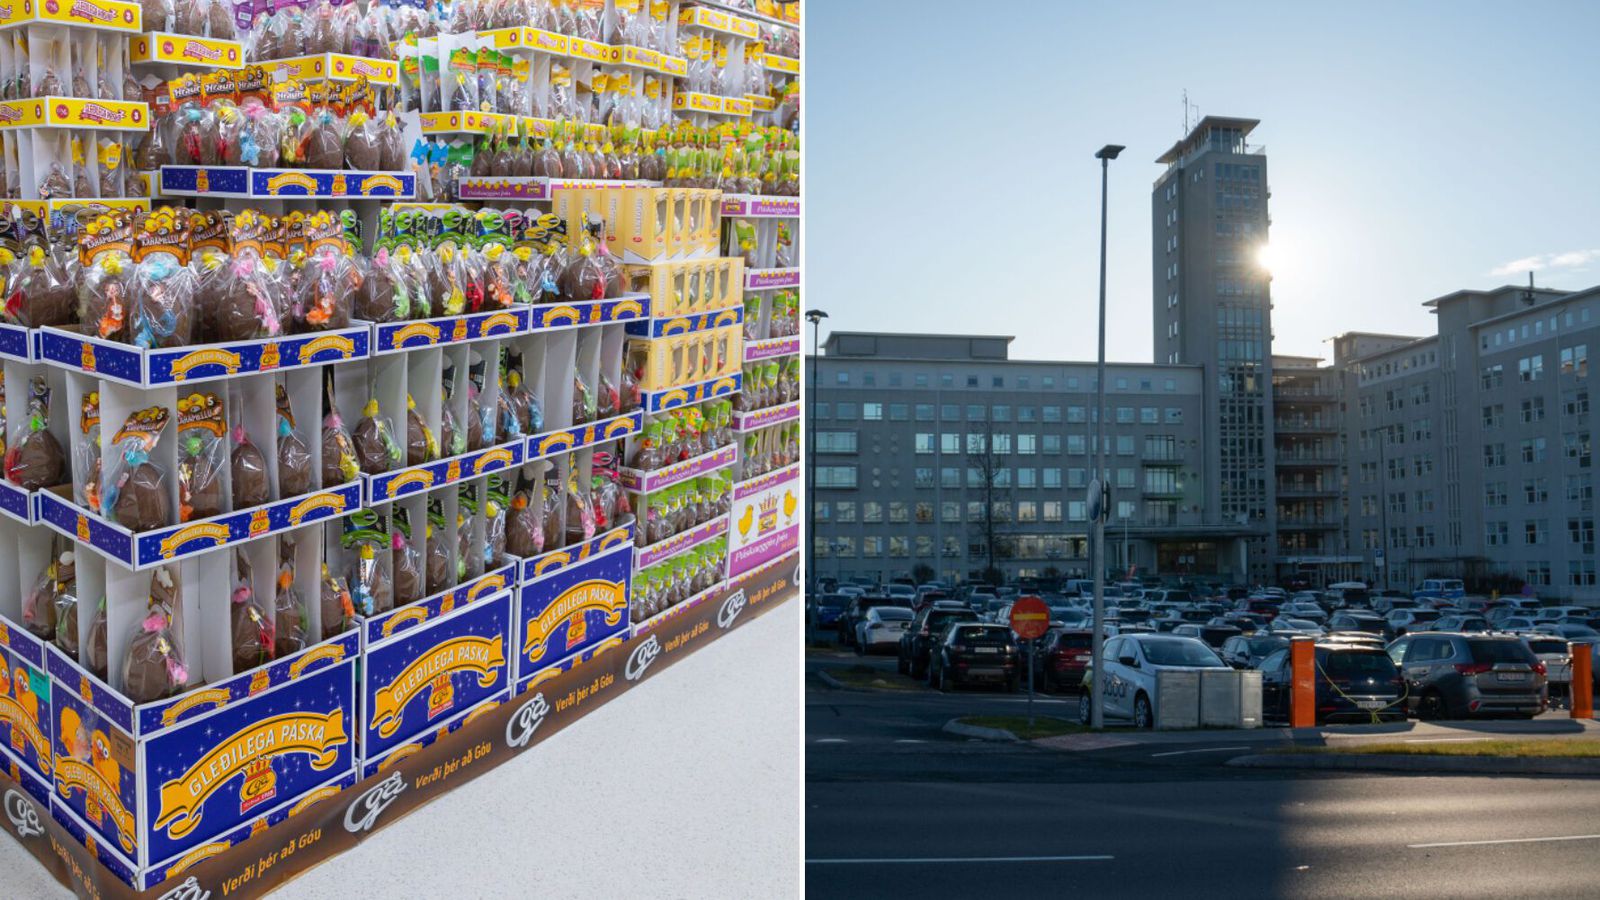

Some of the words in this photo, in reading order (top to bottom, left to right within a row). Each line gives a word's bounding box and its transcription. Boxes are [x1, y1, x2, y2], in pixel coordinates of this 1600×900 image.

[393, 648, 455, 703] GLEÐILEGA
[457, 640, 490, 663] PÁSKA
[189, 729, 276, 797] GLEÐILEGA
[281, 719, 326, 744] PÁSKA
[415, 767, 443, 790] Verði
[443, 760, 460, 780] þér
[461, 750, 472, 768] að
[474, 741, 492, 759] Góu
[222, 863, 255, 897] Verði
[257, 851, 279, 878] þér
[281, 838, 295, 858] að
[298, 827, 322, 849] Góu
